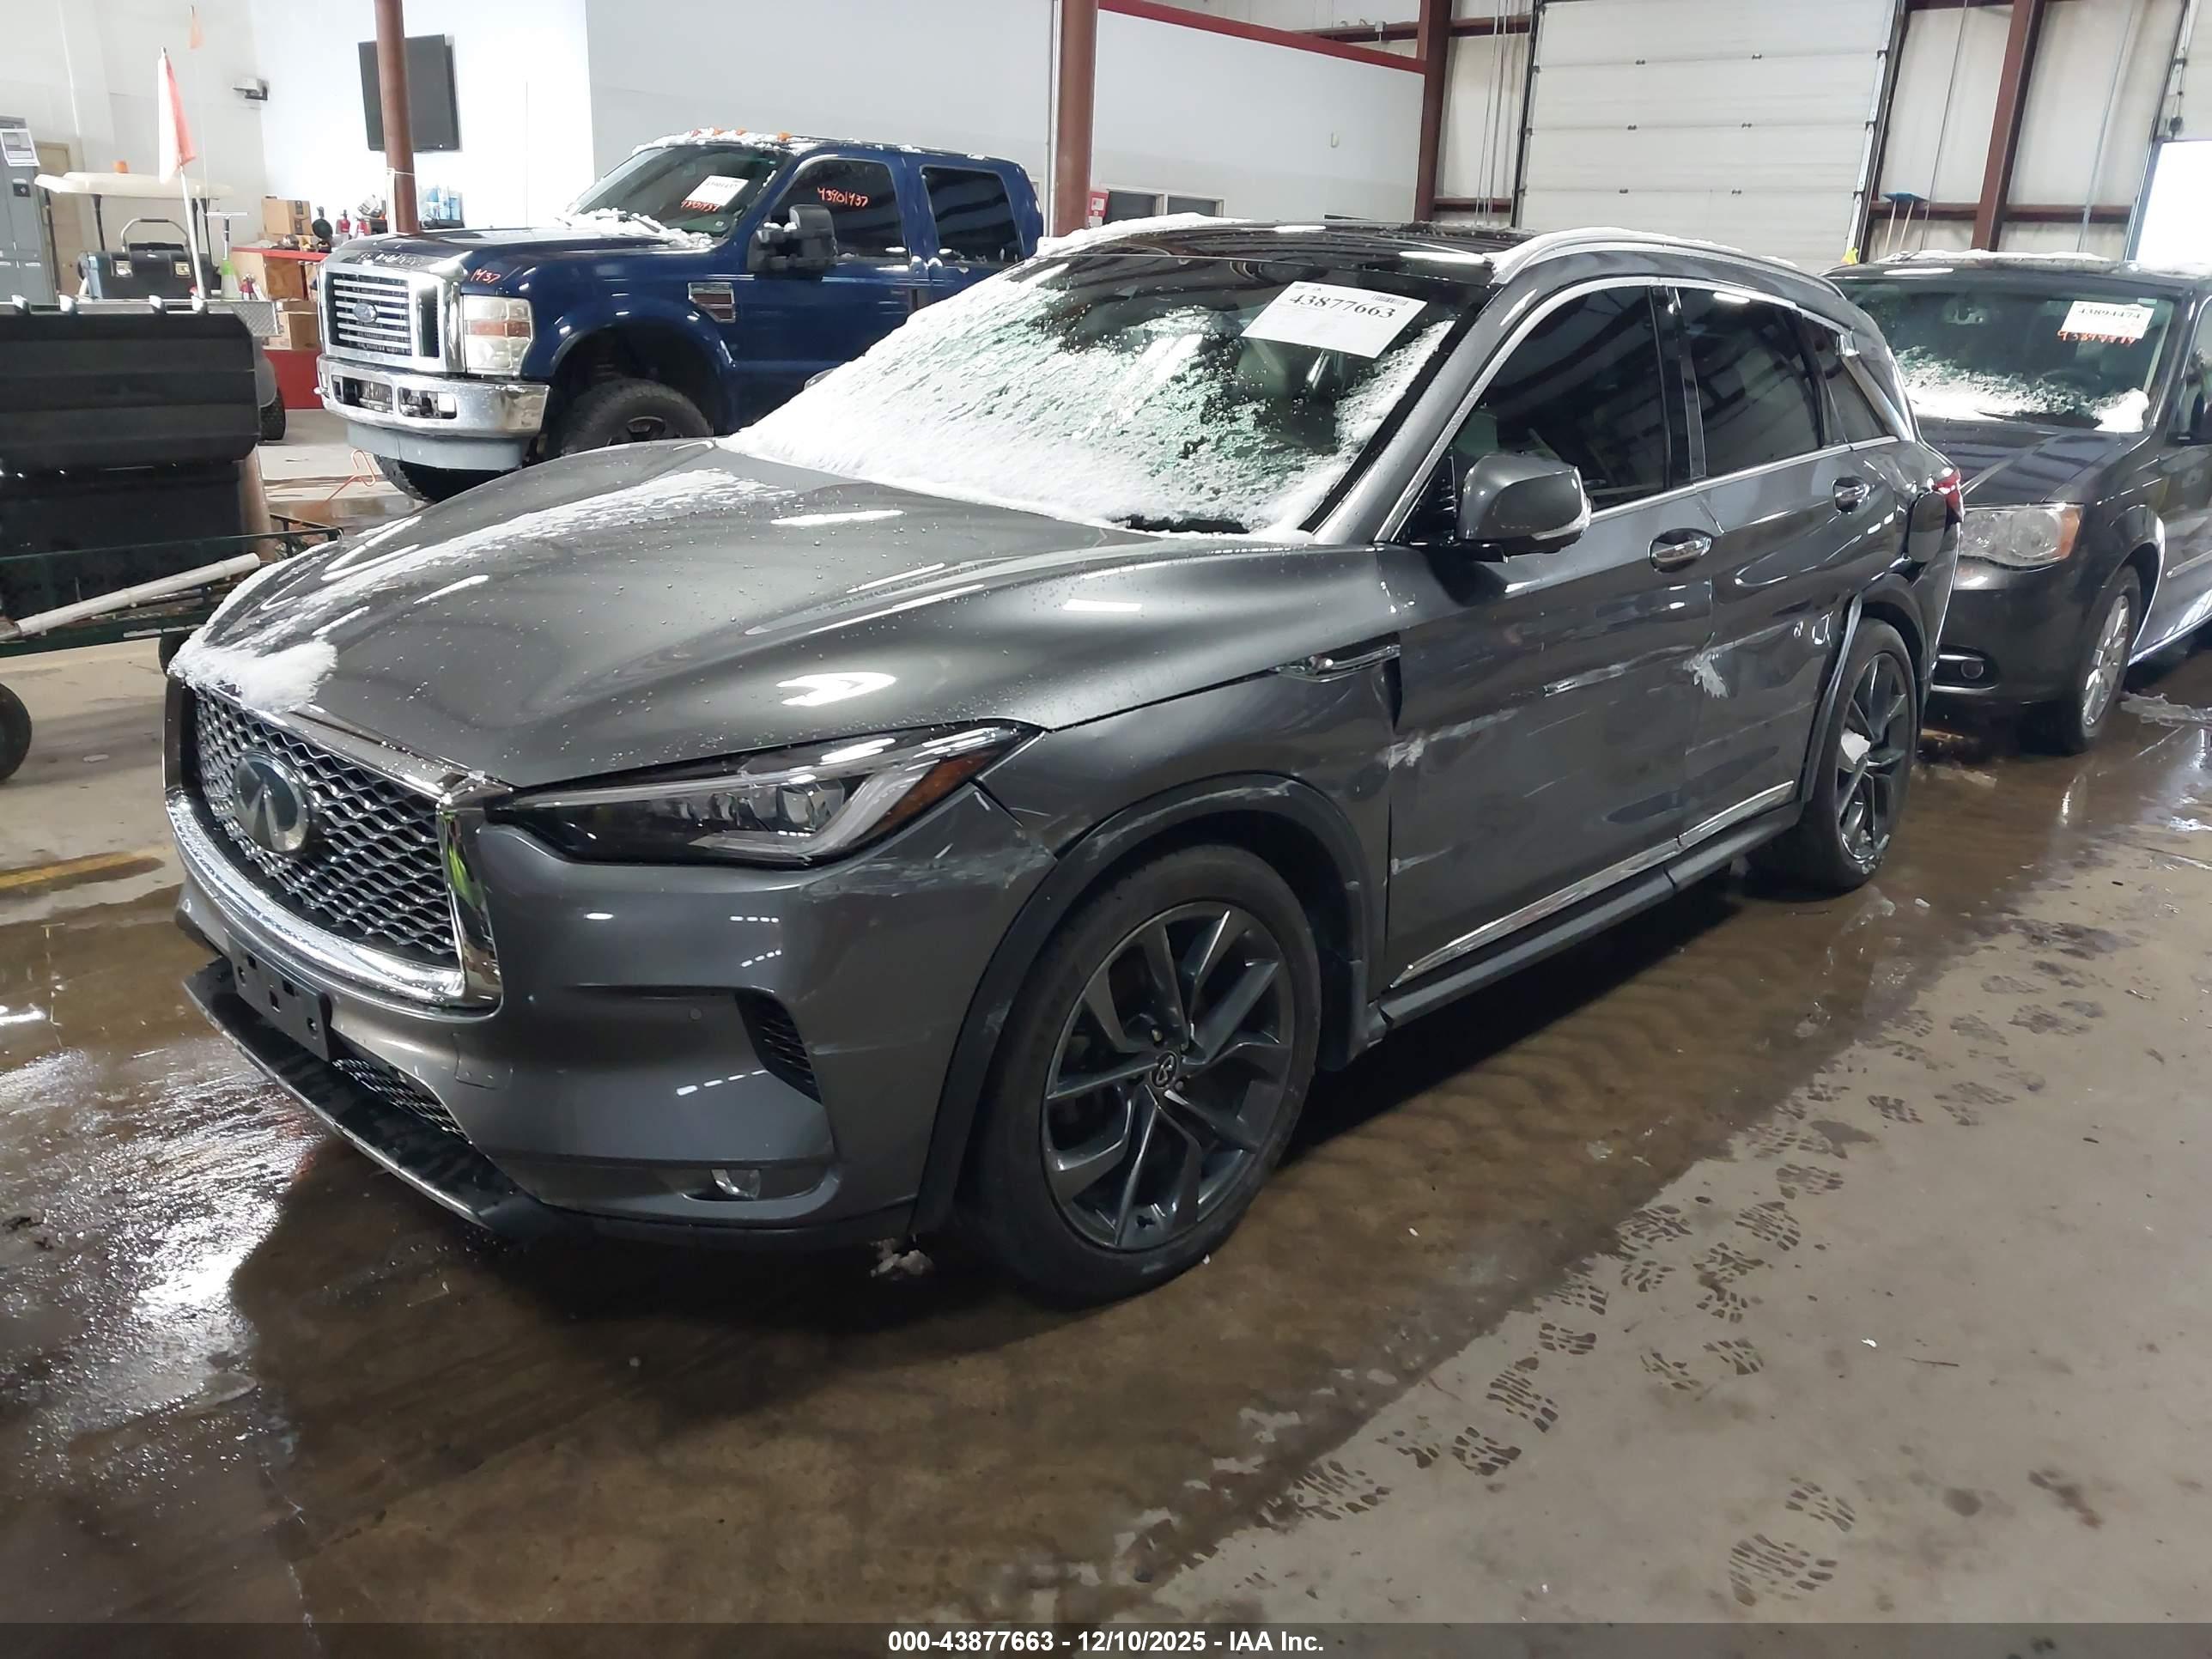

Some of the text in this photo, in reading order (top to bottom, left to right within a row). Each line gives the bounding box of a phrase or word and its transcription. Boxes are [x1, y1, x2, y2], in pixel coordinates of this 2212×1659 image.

[817, 186, 869, 208] 43901437
[471, 268, 501, 284] 1437
[1289, 293, 1396, 319] 43877663
